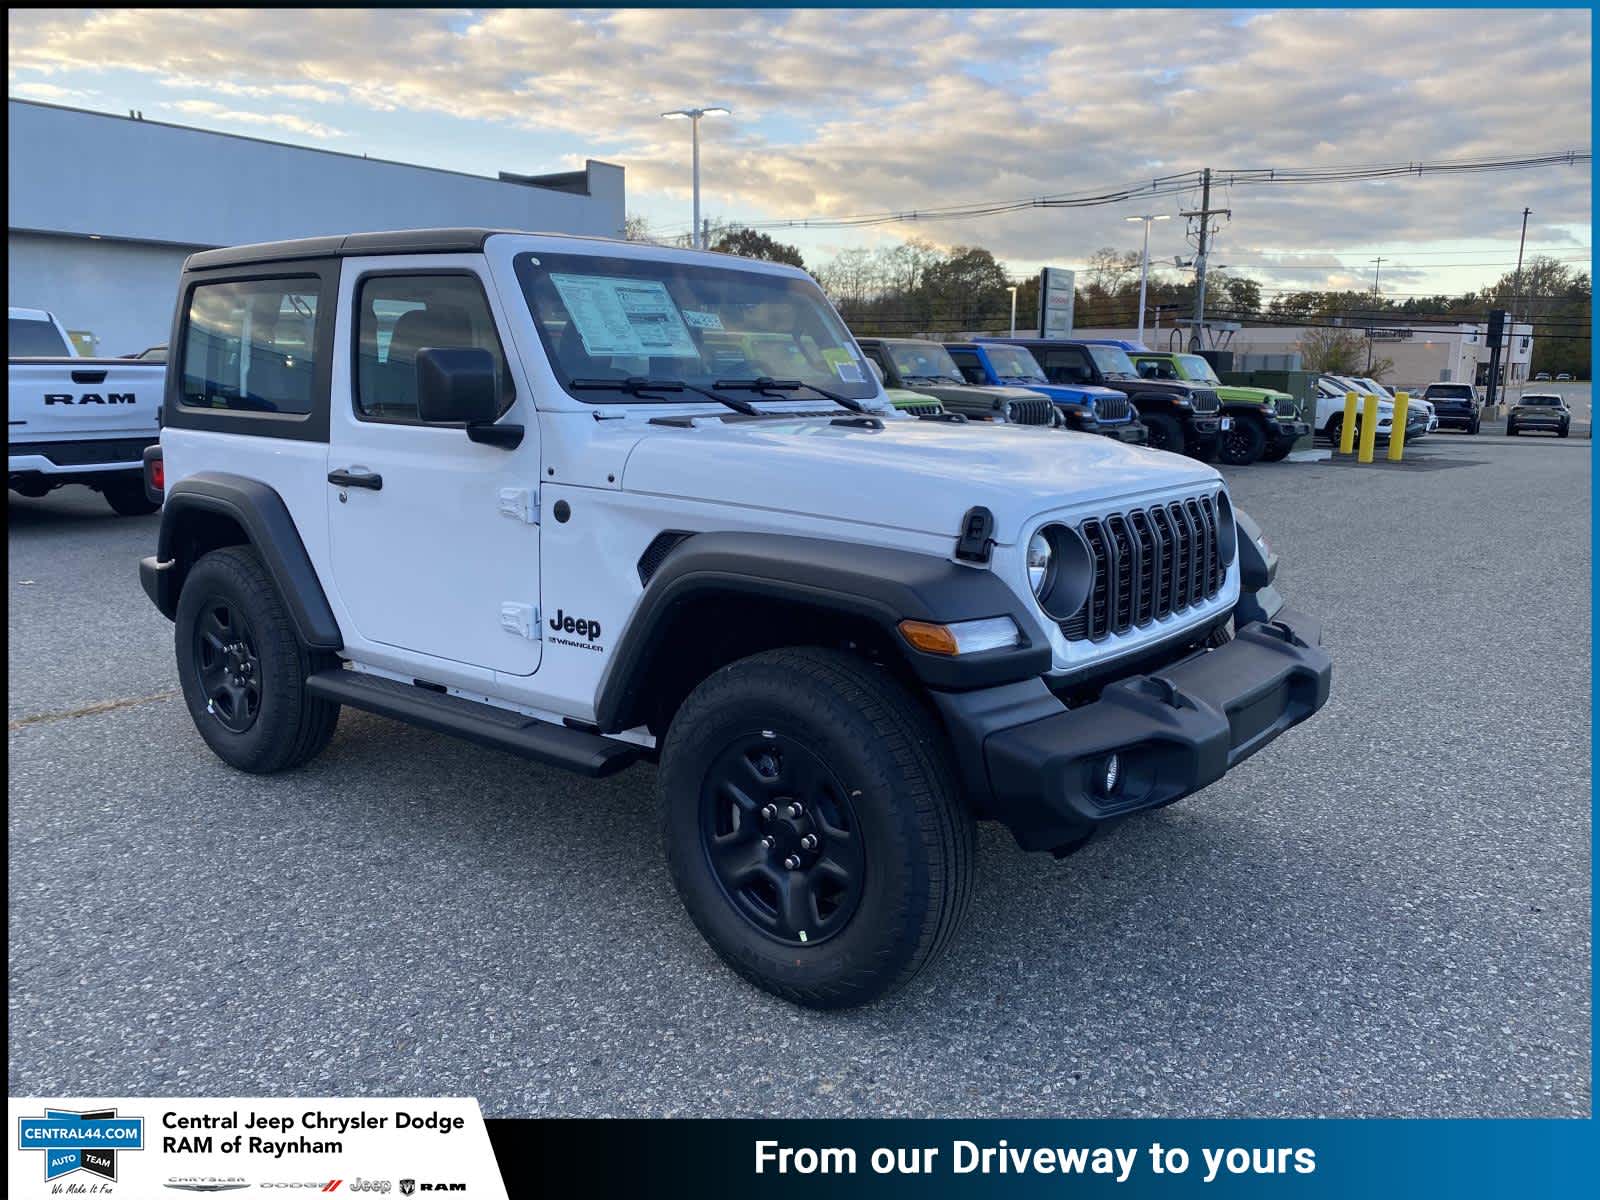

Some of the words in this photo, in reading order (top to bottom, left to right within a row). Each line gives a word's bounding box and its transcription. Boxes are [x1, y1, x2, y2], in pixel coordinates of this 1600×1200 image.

[44, 393, 136, 405] RAM
[549, 608, 601, 642] Jeep
[556, 638, 603, 652] WRANGLER
